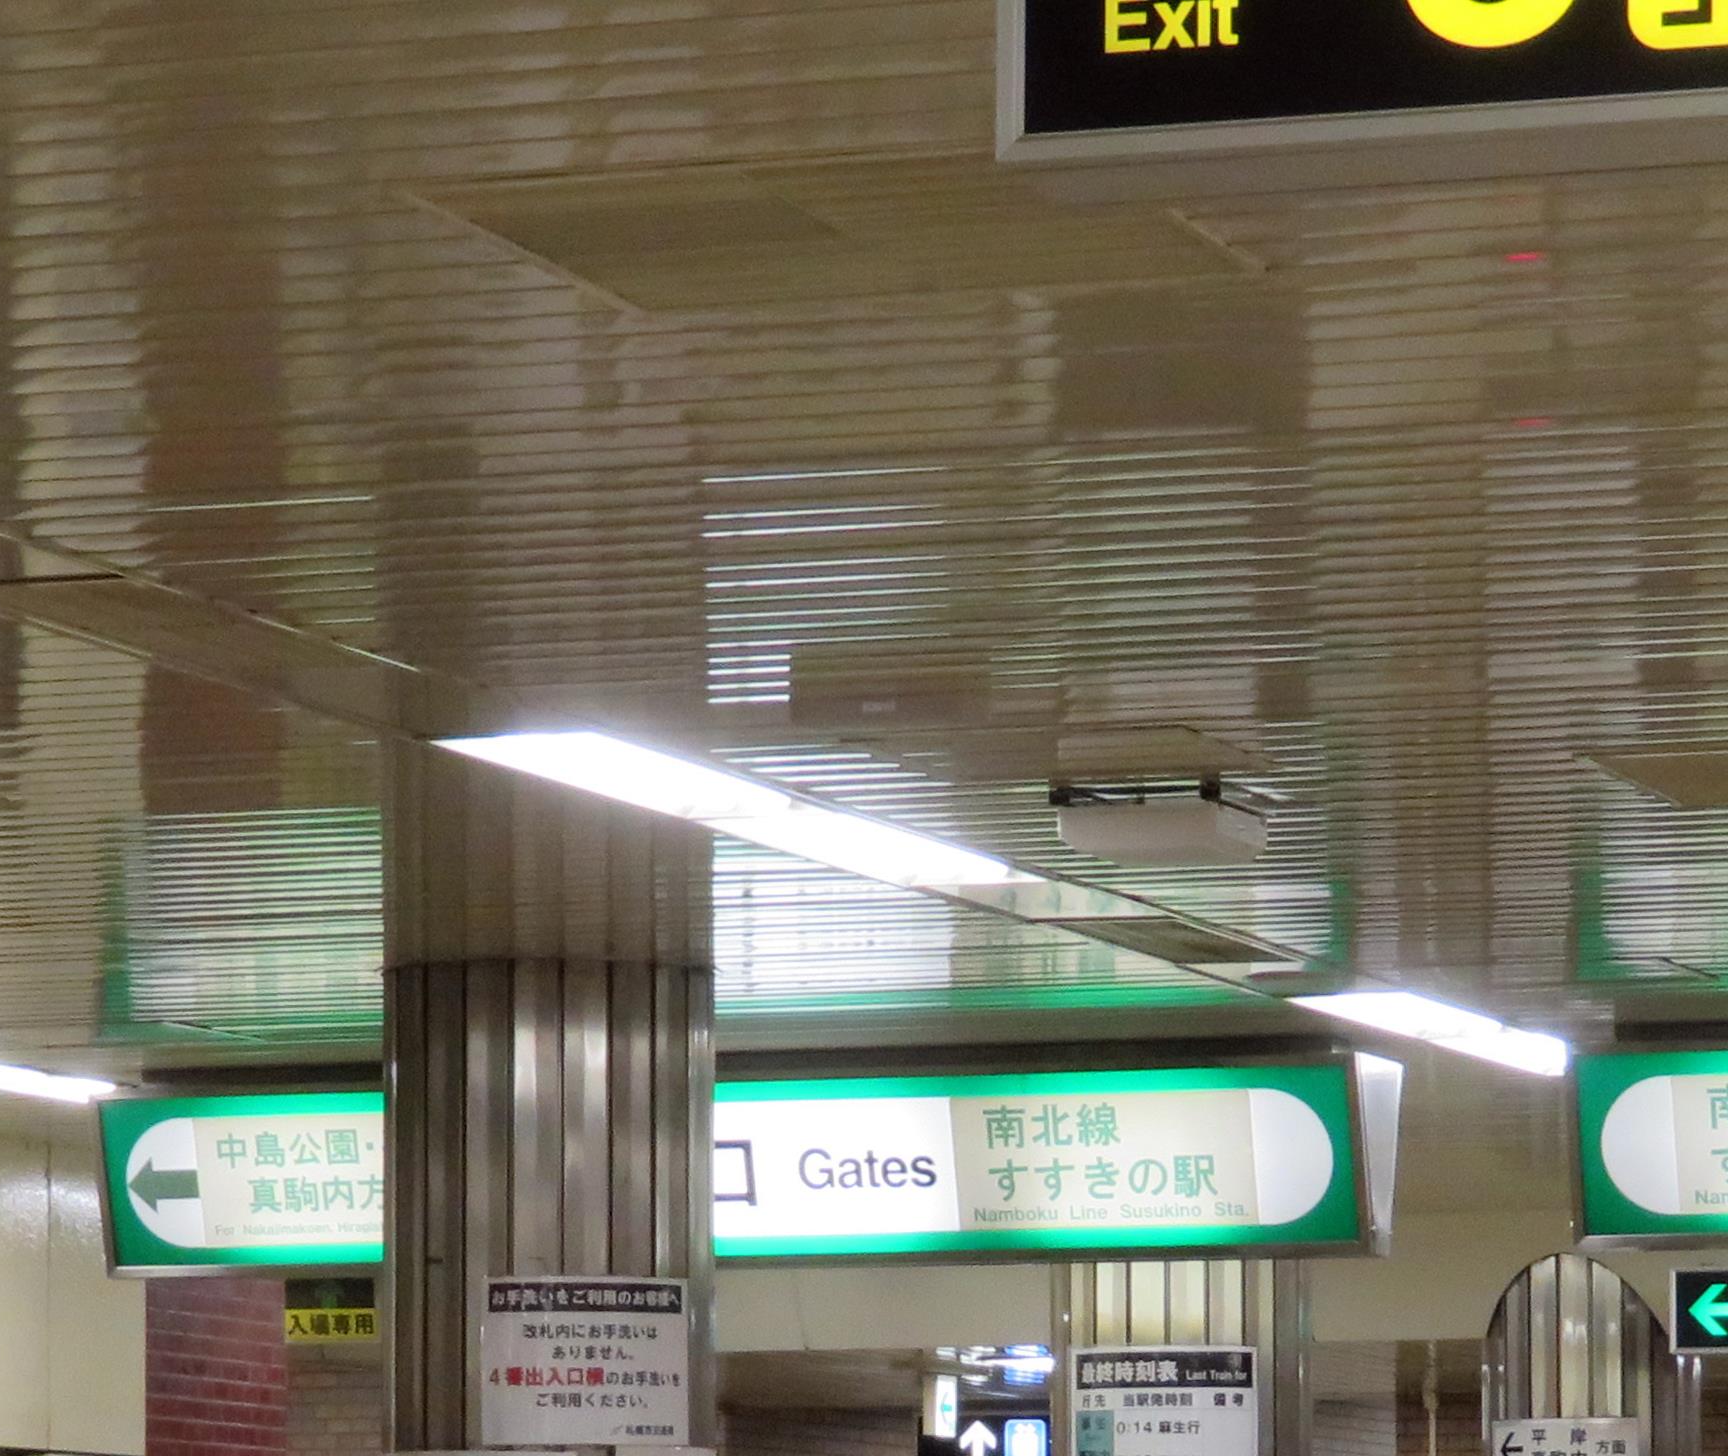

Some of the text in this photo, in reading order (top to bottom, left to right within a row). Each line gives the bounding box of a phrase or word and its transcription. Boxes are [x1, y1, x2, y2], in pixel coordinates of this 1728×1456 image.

[1104, 0, 1239, 54] Exit
[982, 1101, 1121, 1150] 南北線
[798, 1148, 938, 1190] Gates
[987, 1155, 1219, 1202] すすきの駅
[973, 1201, 1250, 1223] Namboku Line Susukino Sta.
[1080, 1360, 1179, 1384] 最終時刻表
[1596, 1440, 1627, 1455] 方面
